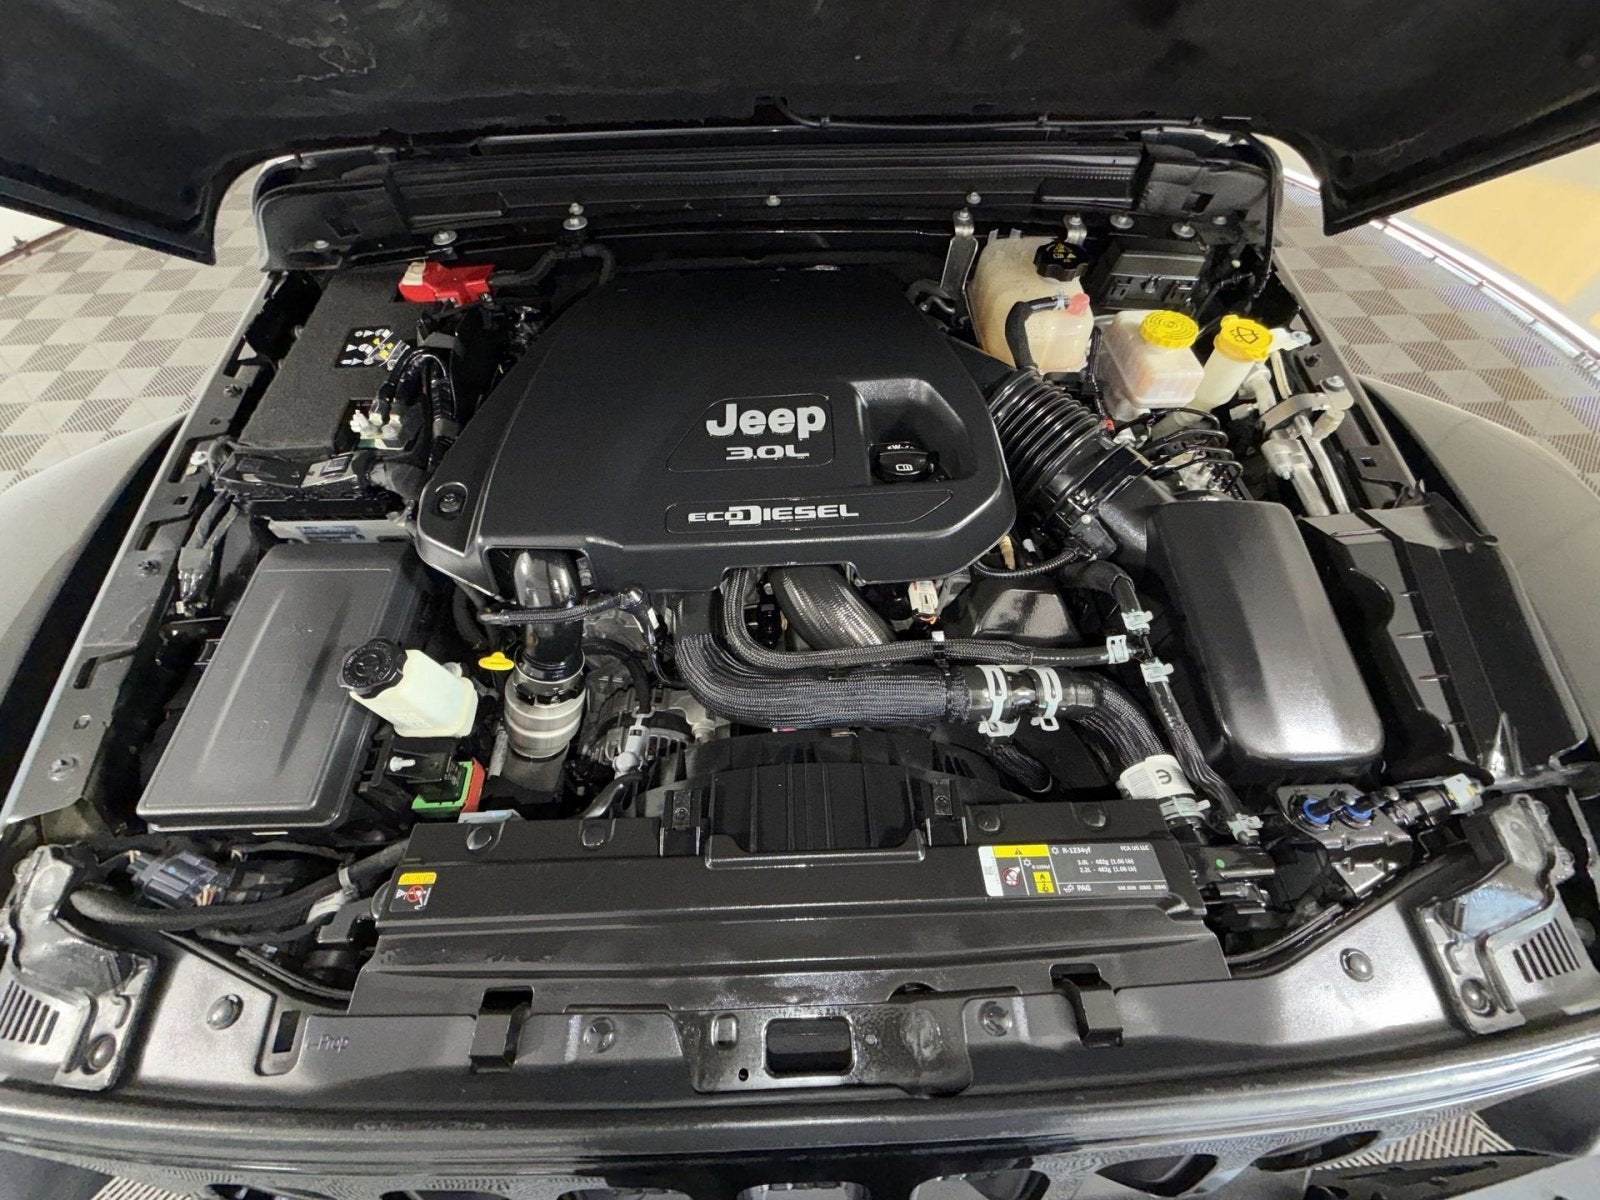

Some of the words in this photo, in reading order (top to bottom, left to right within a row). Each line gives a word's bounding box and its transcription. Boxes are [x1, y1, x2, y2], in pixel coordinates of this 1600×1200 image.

[706, 403, 826, 440] Jeep
[726, 445, 810, 461] 3.0L
[688, 504, 859, 526] ECODIESEL
[1062, 846, 1091, 855] R-1234yf
[1076, 884, 1092, 892] PAG
